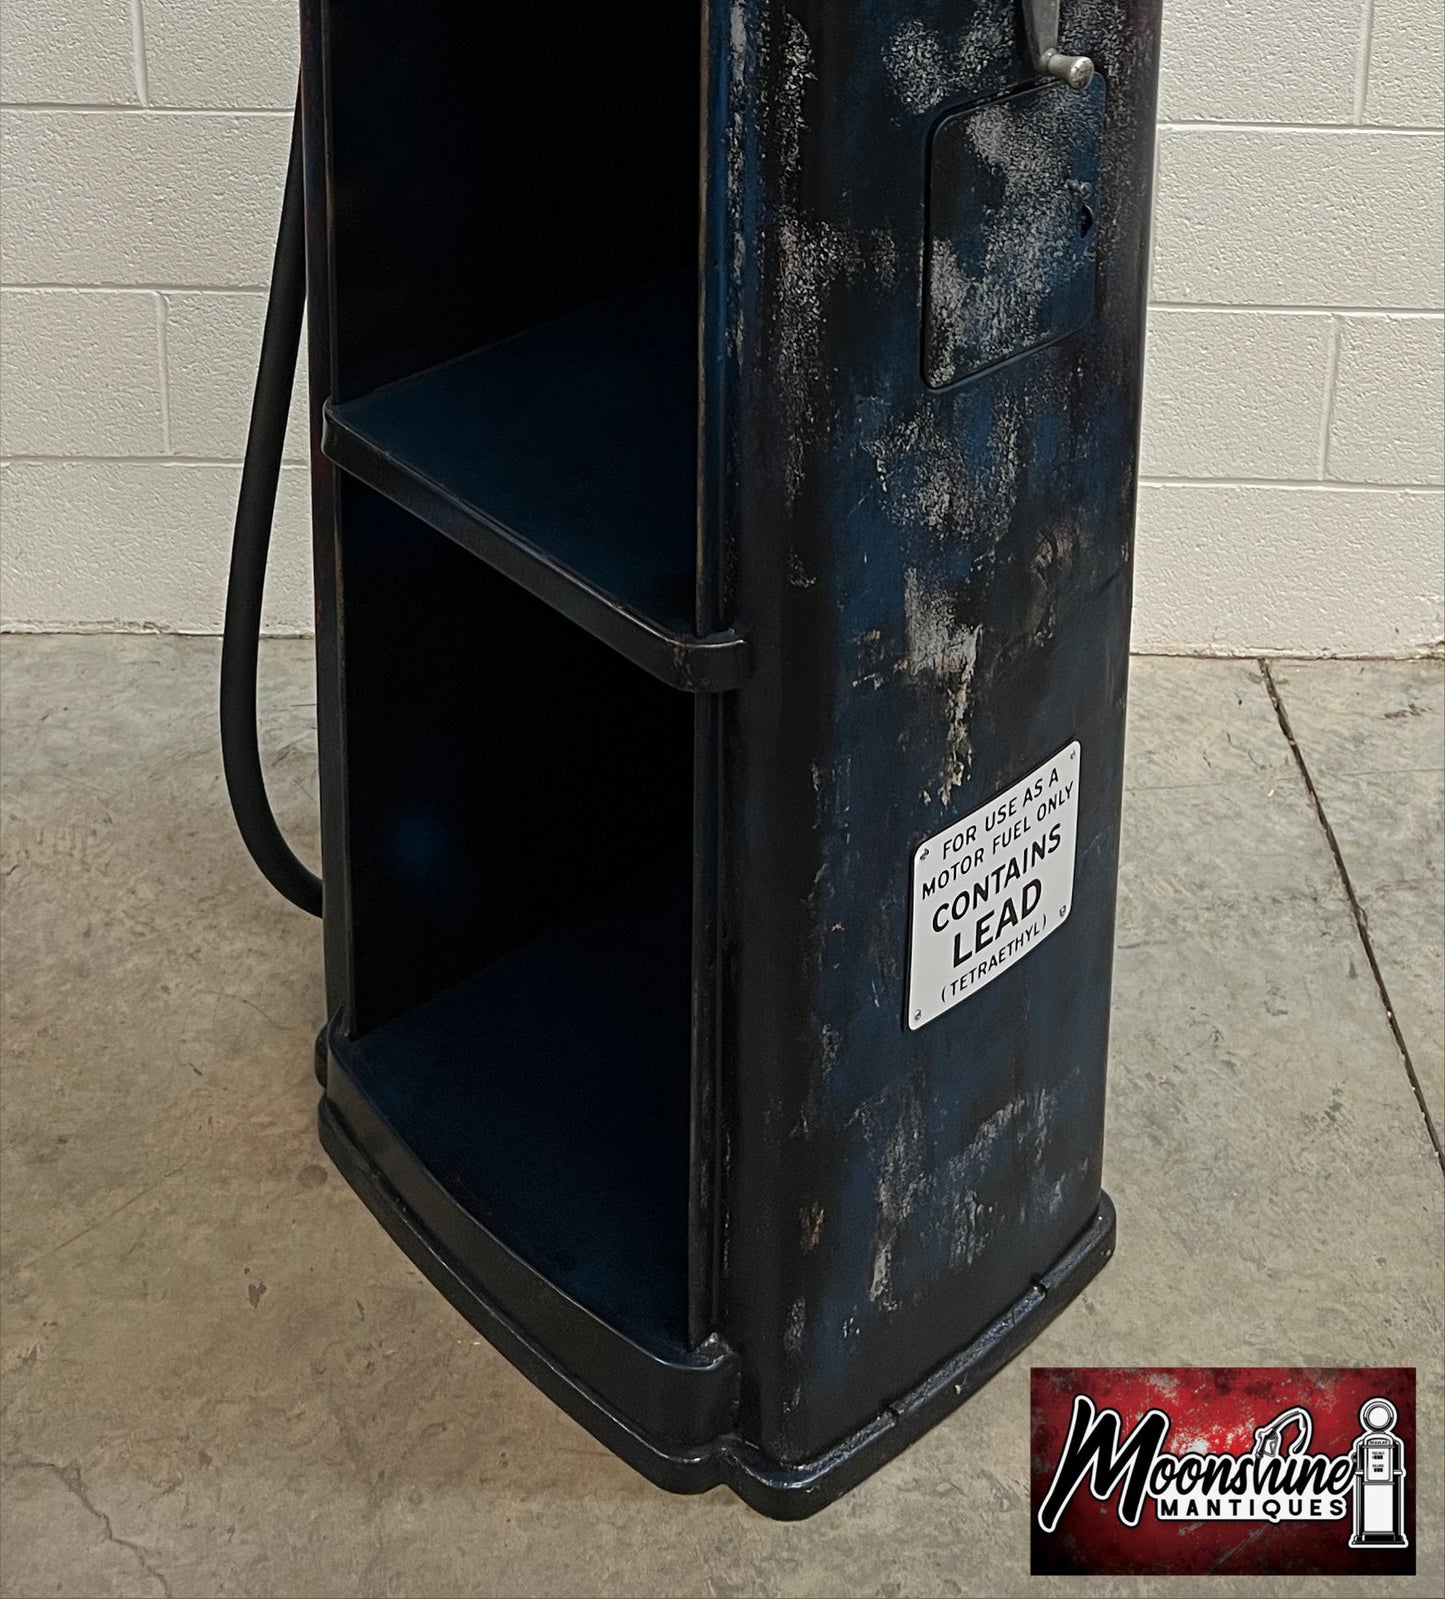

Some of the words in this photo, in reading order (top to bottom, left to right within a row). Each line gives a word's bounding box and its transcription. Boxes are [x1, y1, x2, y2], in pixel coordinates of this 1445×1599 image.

[922, 848, 984, 900] MOTOR
[992, 818, 1031, 855] FUEL
[1037, 781, 1074, 821] ONLY
[943, 825, 976, 859] FOR
[985, 797, 1018, 831] USE
[1023, 781, 1043, 807] AS
[1048, 767, 1059, 788] A
[932, 823, 1061, 933] CONTAINS
[953, 878, 1042, 968] LEAD
[941, 914, 1047, 1003] (TETRAETHYL)
